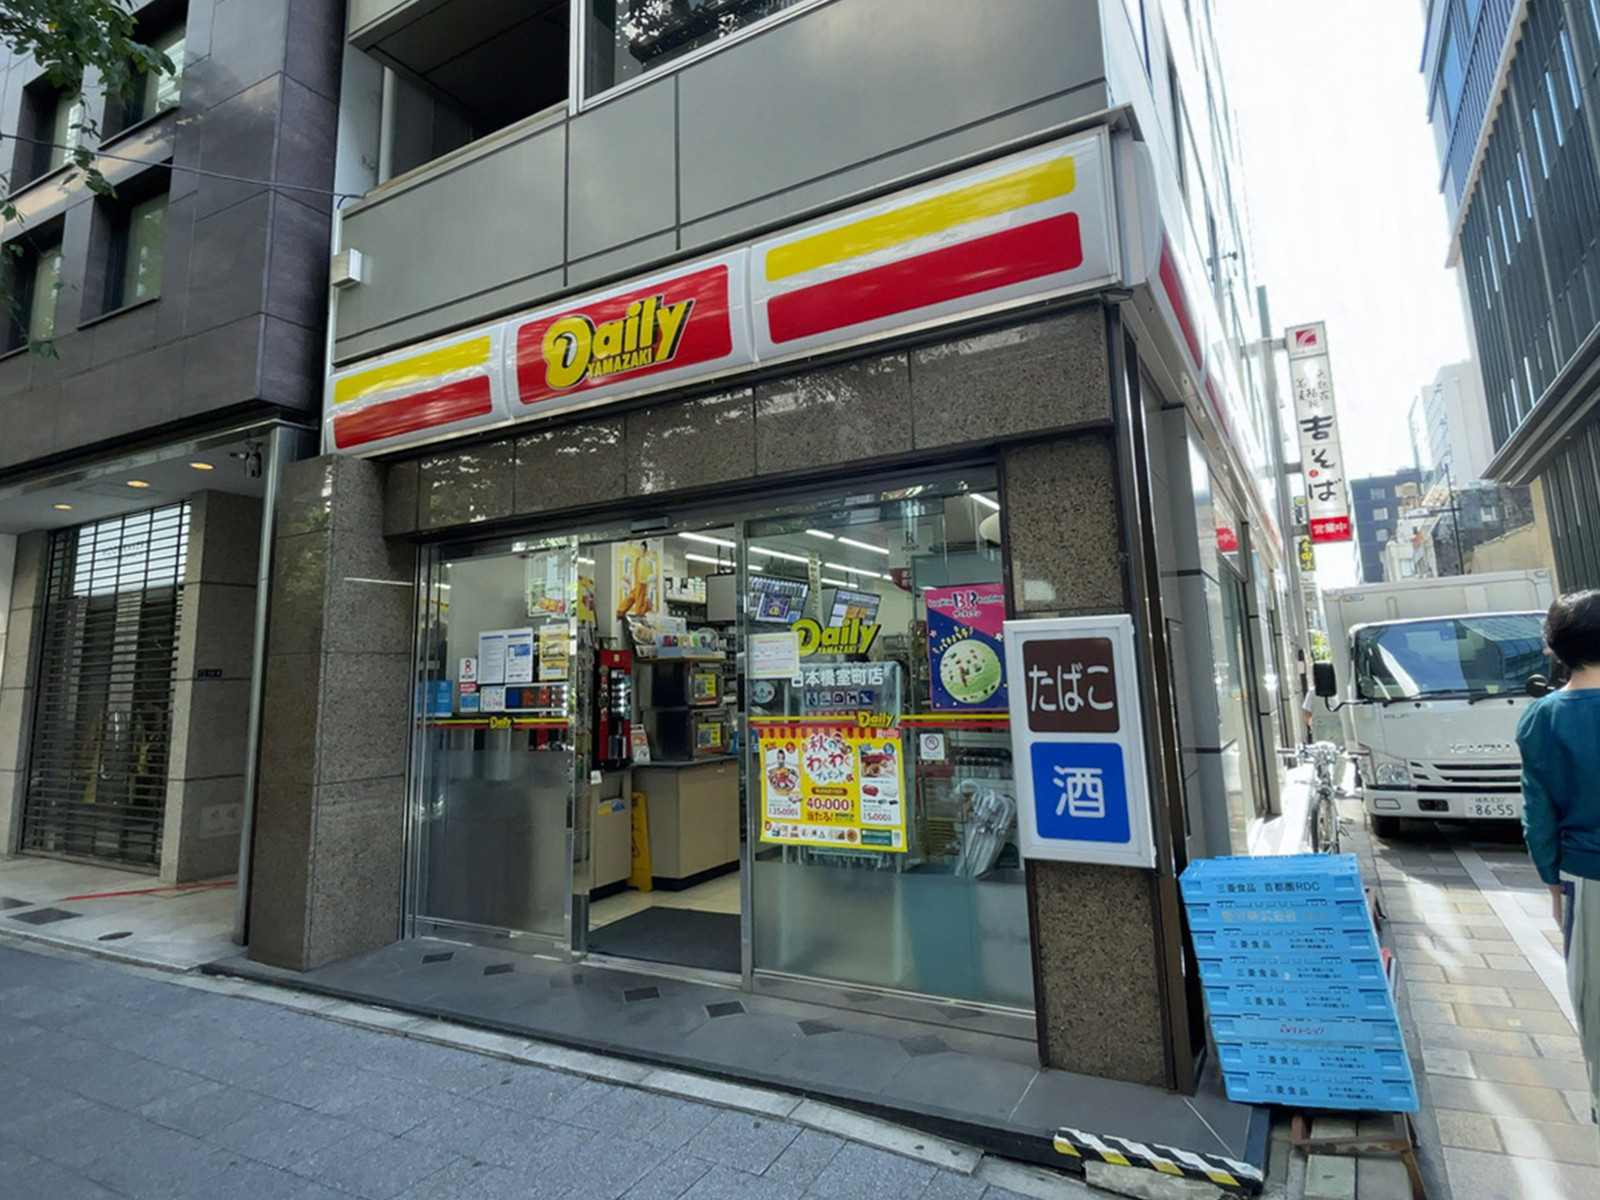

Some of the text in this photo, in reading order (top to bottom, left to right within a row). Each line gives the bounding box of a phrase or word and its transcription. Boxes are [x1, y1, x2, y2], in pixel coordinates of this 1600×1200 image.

[542, 295, 694, 388] Daily
[588, 348, 652, 378] YAMAZAKI
[1300, 415, 1341, 500] 吉そば
[1313, 523, 1347, 535] 営業中
[953, 591, 977, 609] BR
[791, 618, 881, 657] Daily
[791, 667, 884, 687] 日本橋室町店
[1028, 663, 1114, 712] たばこ
[858, 711, 894, 728] Daily
[809, 734, 837, 752] 秋の
[806, 752, 851, 771] わくわく
[1053, 765, 1106, 818] 酒
[806, 797, 850, 812] 40,000
[1475, 804, 1515, 816] 86-55
[1217, 882, 1257, 893] 三菱食品
